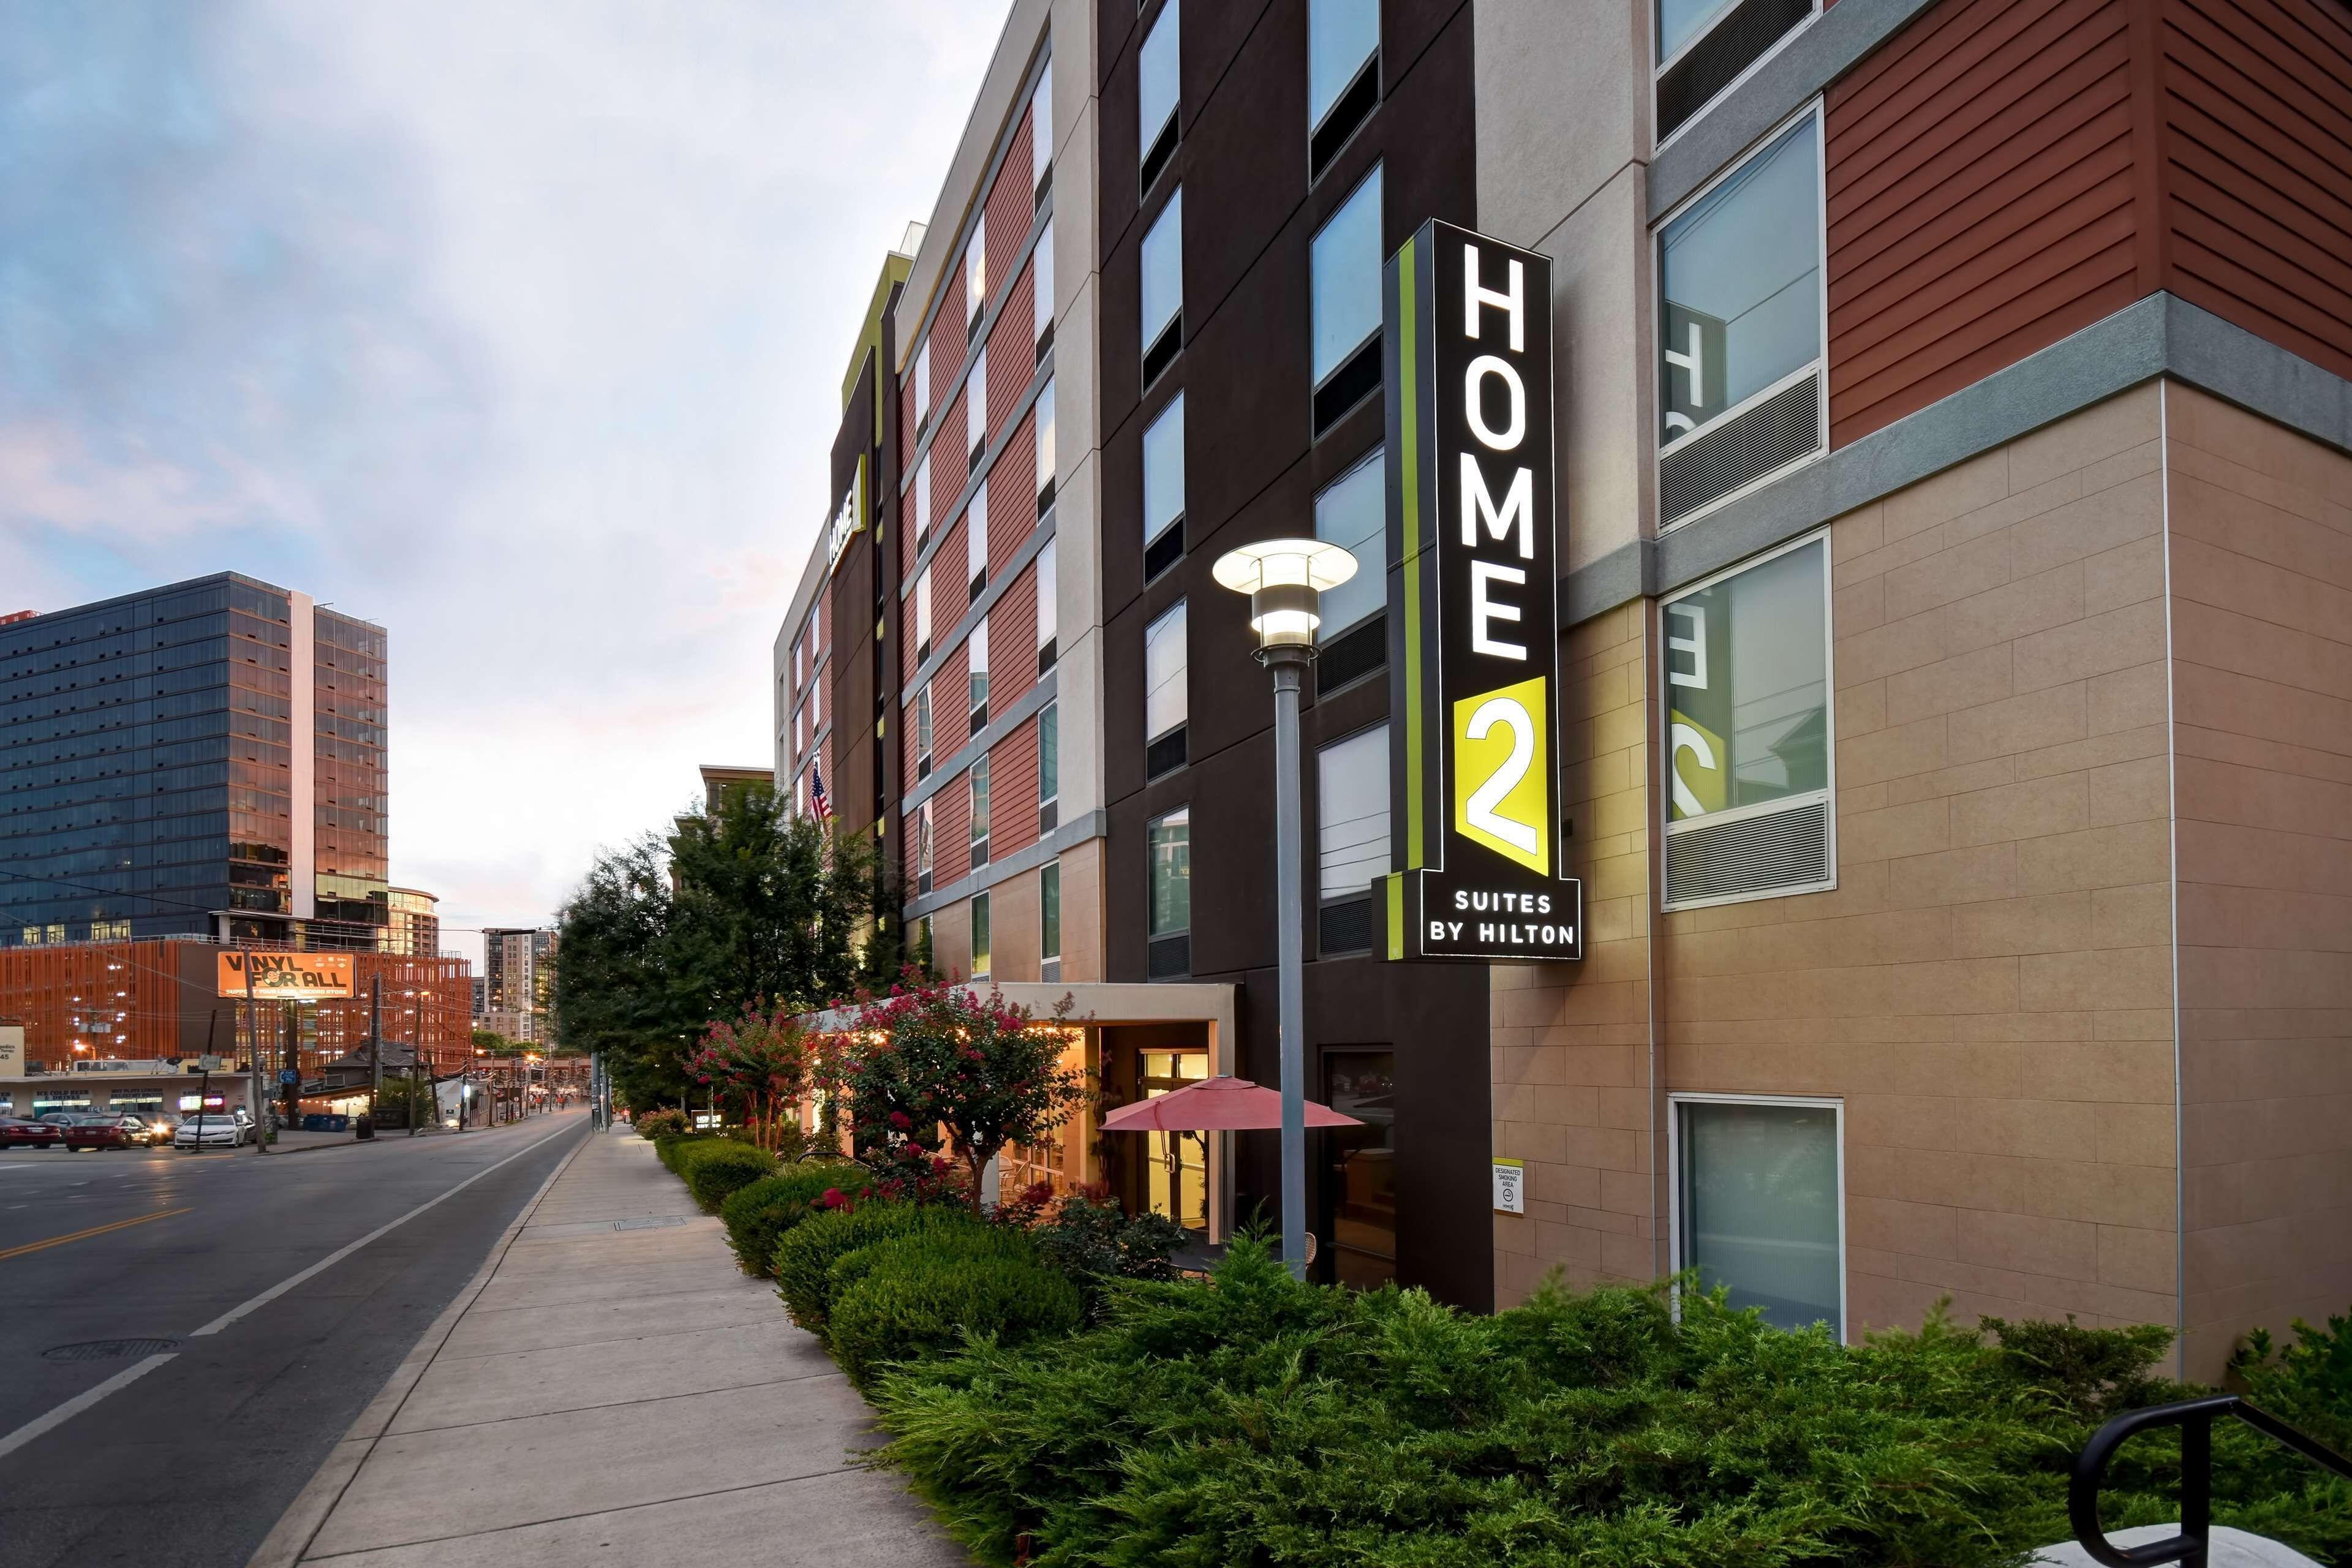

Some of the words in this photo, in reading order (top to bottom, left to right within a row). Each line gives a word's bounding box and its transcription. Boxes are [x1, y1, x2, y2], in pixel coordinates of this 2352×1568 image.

[1460, 243, 1534, 661] HOME
[1464, 697, 1537, 856] 2
[1455, 890, 1551, 914] SUITES
[1430, 921, 1463, 941] BY
[1479, 923, 1574, 944] HILTON
[225, 956, 303, 971] VNYL
[251, 967, 299, 987] FOR
[303, 972, 347, 987] ALL
